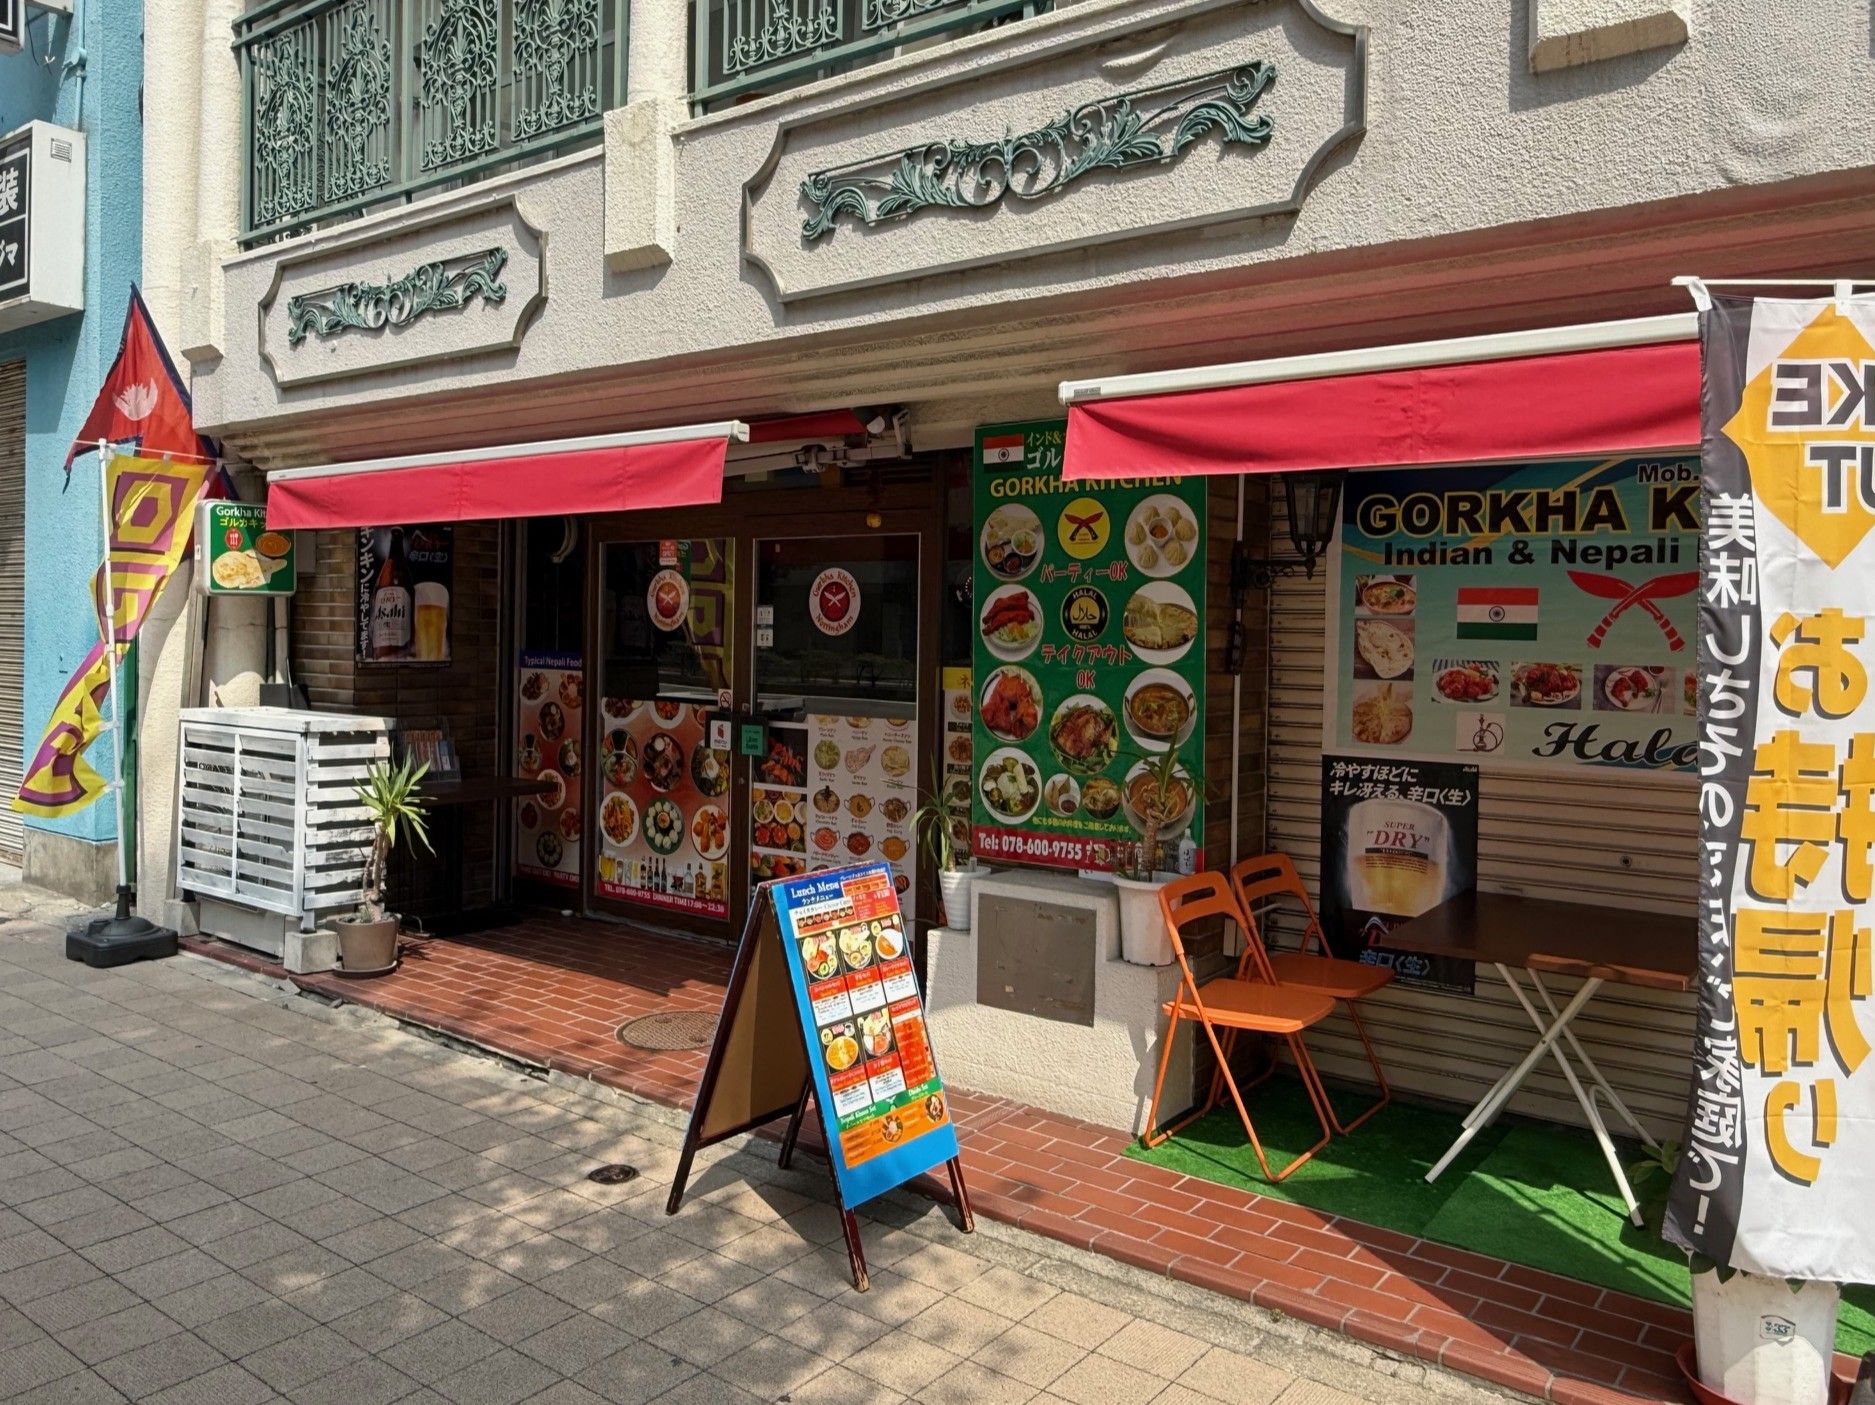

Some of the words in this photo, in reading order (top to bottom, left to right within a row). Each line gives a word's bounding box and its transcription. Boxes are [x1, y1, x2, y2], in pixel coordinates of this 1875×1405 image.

[1027, 431, 1067, 447] インド&
[1026, 447, 1062, 470] ゴル
[1637, 463, 1699, 483] Mob.
[990, 476, 1079, 497] GORKHA
[216, 506, 252, 517] Gorkha
[1356, 485, 1631, 537] GORKHA
[1383, 541, 1493, 566] Indian
[1507, 540, 1535, 564] &
[1550, 537, 1679, 570] Nepali
[1040, 561, 1128, 583] パーティーOK
[1072, 590, 1097, 601] HALAL
[1071, 629, 1098, 641] HALAL
[1040, 644, 1133, 666] テイクアウト
[1076, 669, 1095, 690] OK
[1329, 761, 1419, 783] 冷やすほどに
[1384, 820, 1416, 831] SUPER
[979, 832, 999, 851] Tel:
[1002, 835, 1082, 860] 078-600-9755
[791, 885, 816, 899] Lunch
[817, 880, 839, 893] Menu
